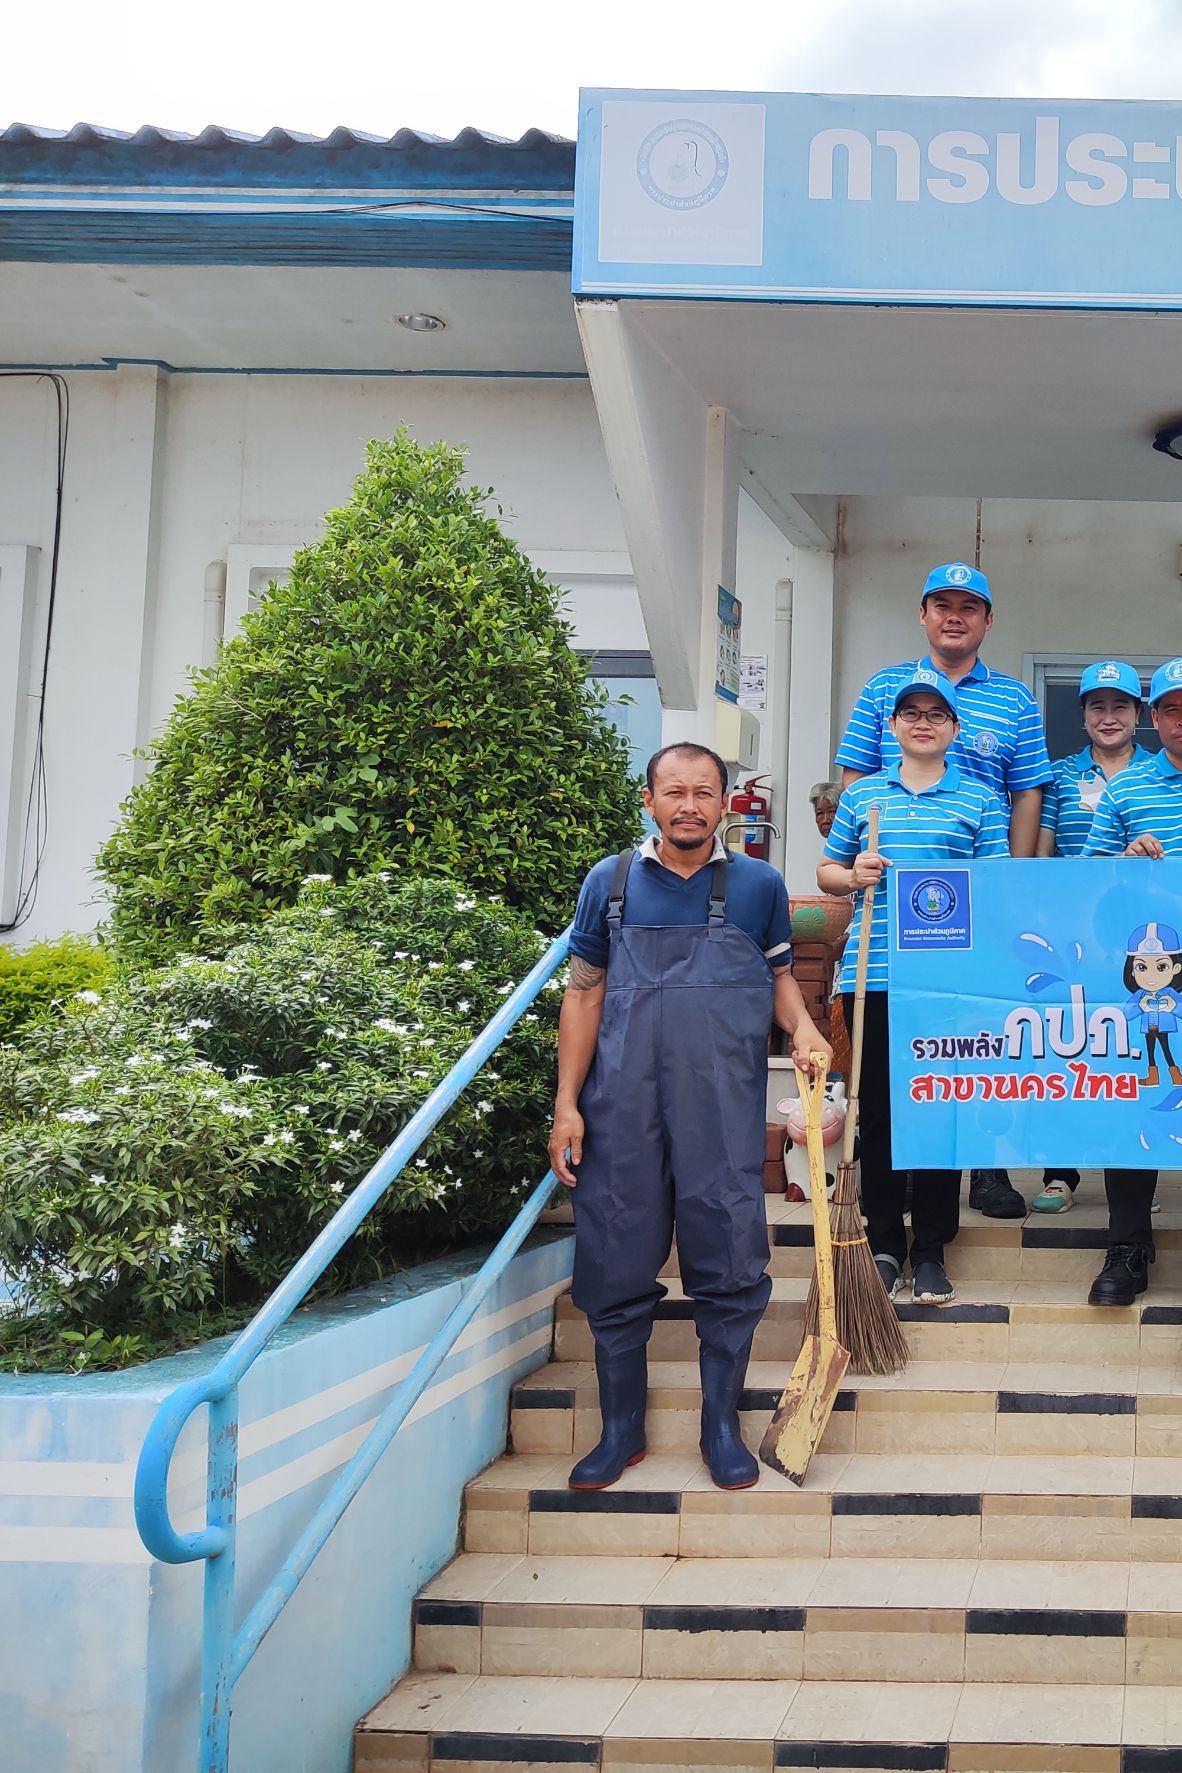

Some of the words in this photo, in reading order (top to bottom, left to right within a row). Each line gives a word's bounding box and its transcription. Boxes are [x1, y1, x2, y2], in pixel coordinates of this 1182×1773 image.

[912, 1030, 1004, 1060] รวมพลัง
[1003, 984, 1142, 1061] กปภ.
[910, 1061, 1139, 1101] สาขานครไทย
